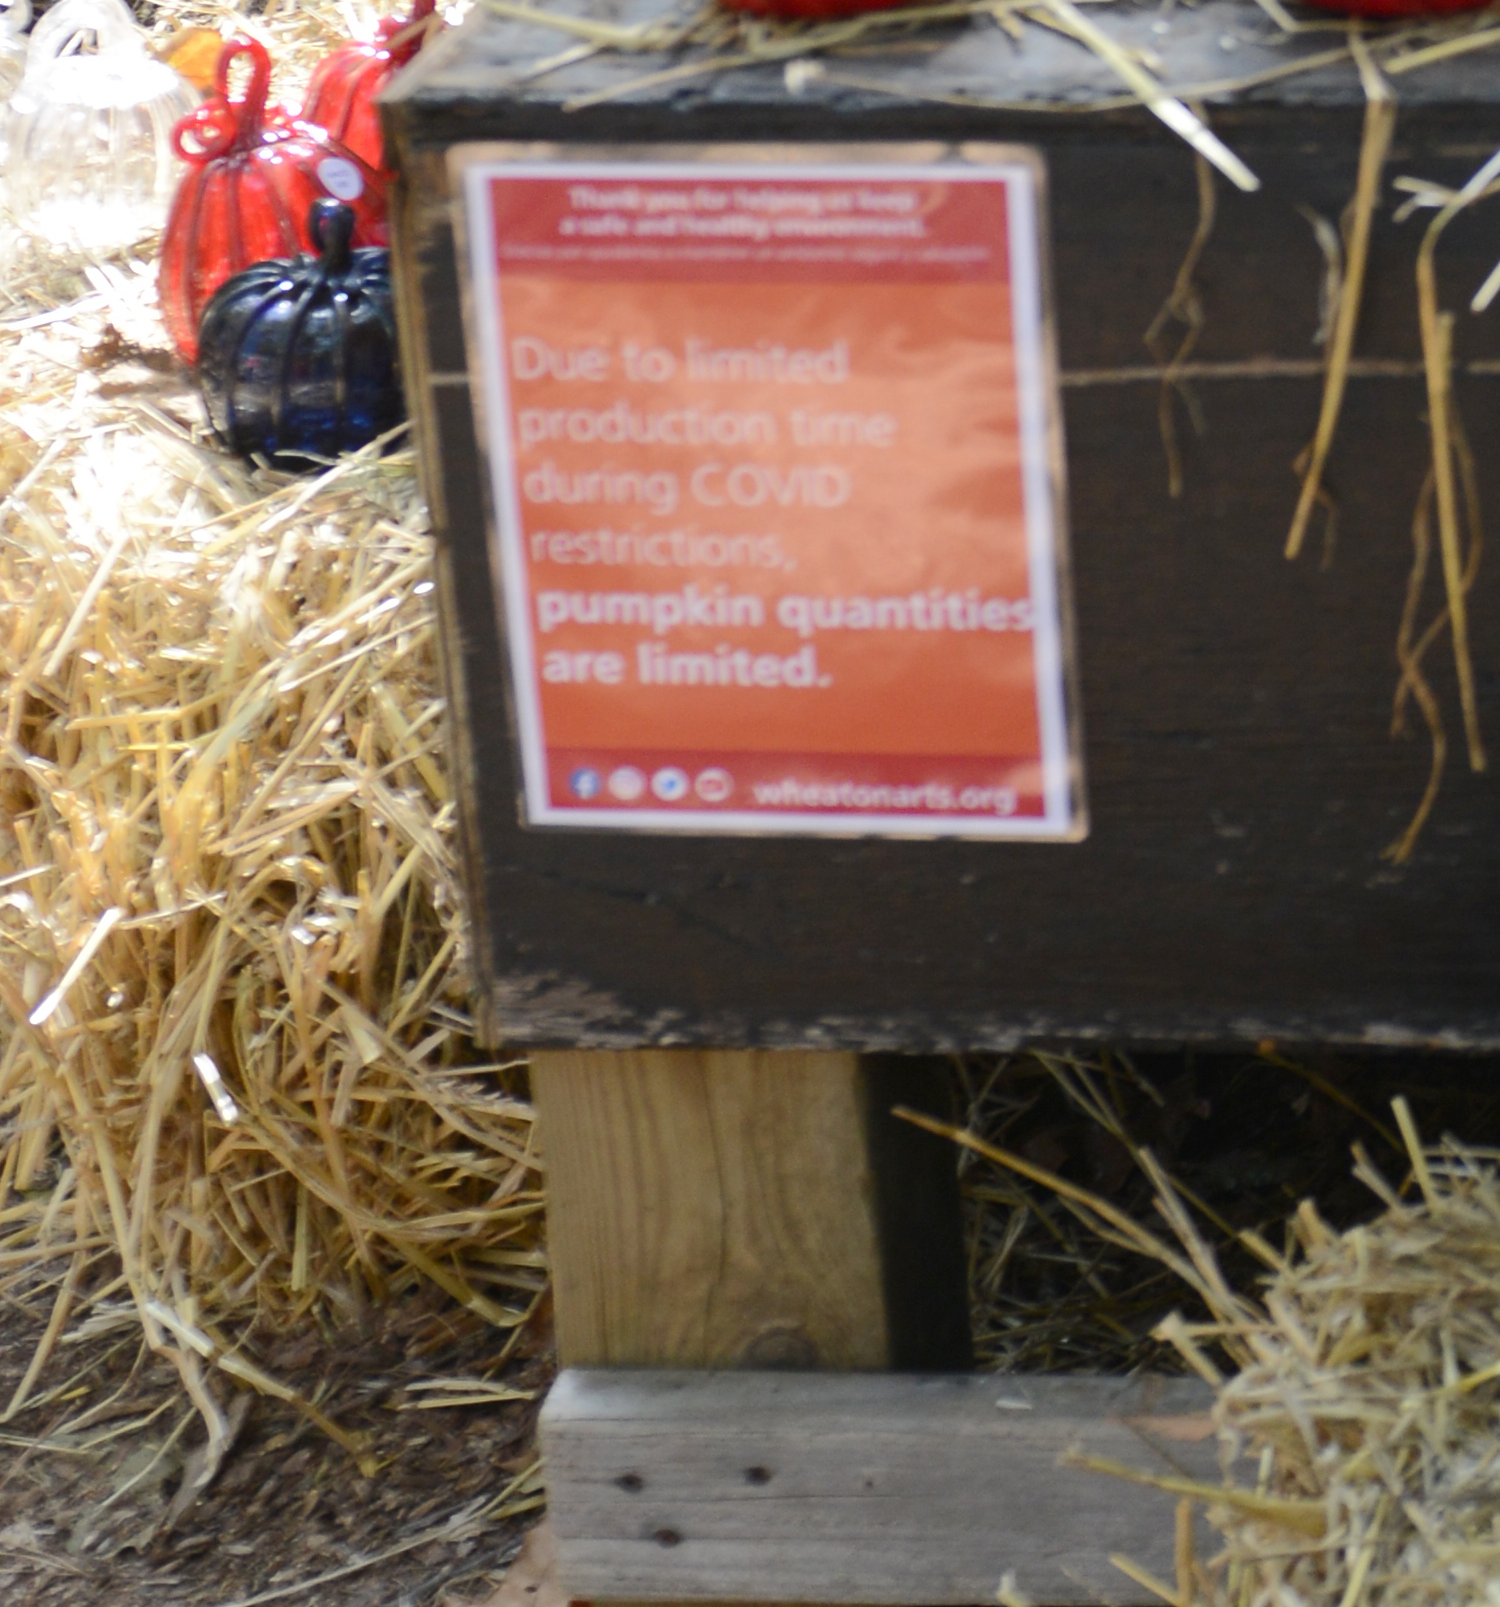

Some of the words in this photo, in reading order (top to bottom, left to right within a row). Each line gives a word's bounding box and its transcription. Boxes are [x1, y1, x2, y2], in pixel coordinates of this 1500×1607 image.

[570, 187, 641, 211] Thank
[645, 192, 689, 215] you
[693, 187, 728, 211] for
[732, 187, 822, 216] helping
[579, 214, 629, 236] safe
[634, 214, 677, 236] and
[681, 214, 770, 241] healthy
[511, 338, 606, 382] Due
[624, 345, 675, 383] to
[686, 339, 848, 385] limited
[520, 404, 777, 449] production
[789, 406, 896, 447] time
[524, 464, 678, 513] during
[692, 465, 849, 508] COVID
[530, 527, 798, 571] restrictions,
[538, 586, 763, 633] pumpkin
[777, 589, 1036, 638] quantities
[543, 650, 624, 684] are
[637, 646, 831, 688] limited.
[754, 776, 1017, 814] wheatonarts.org
